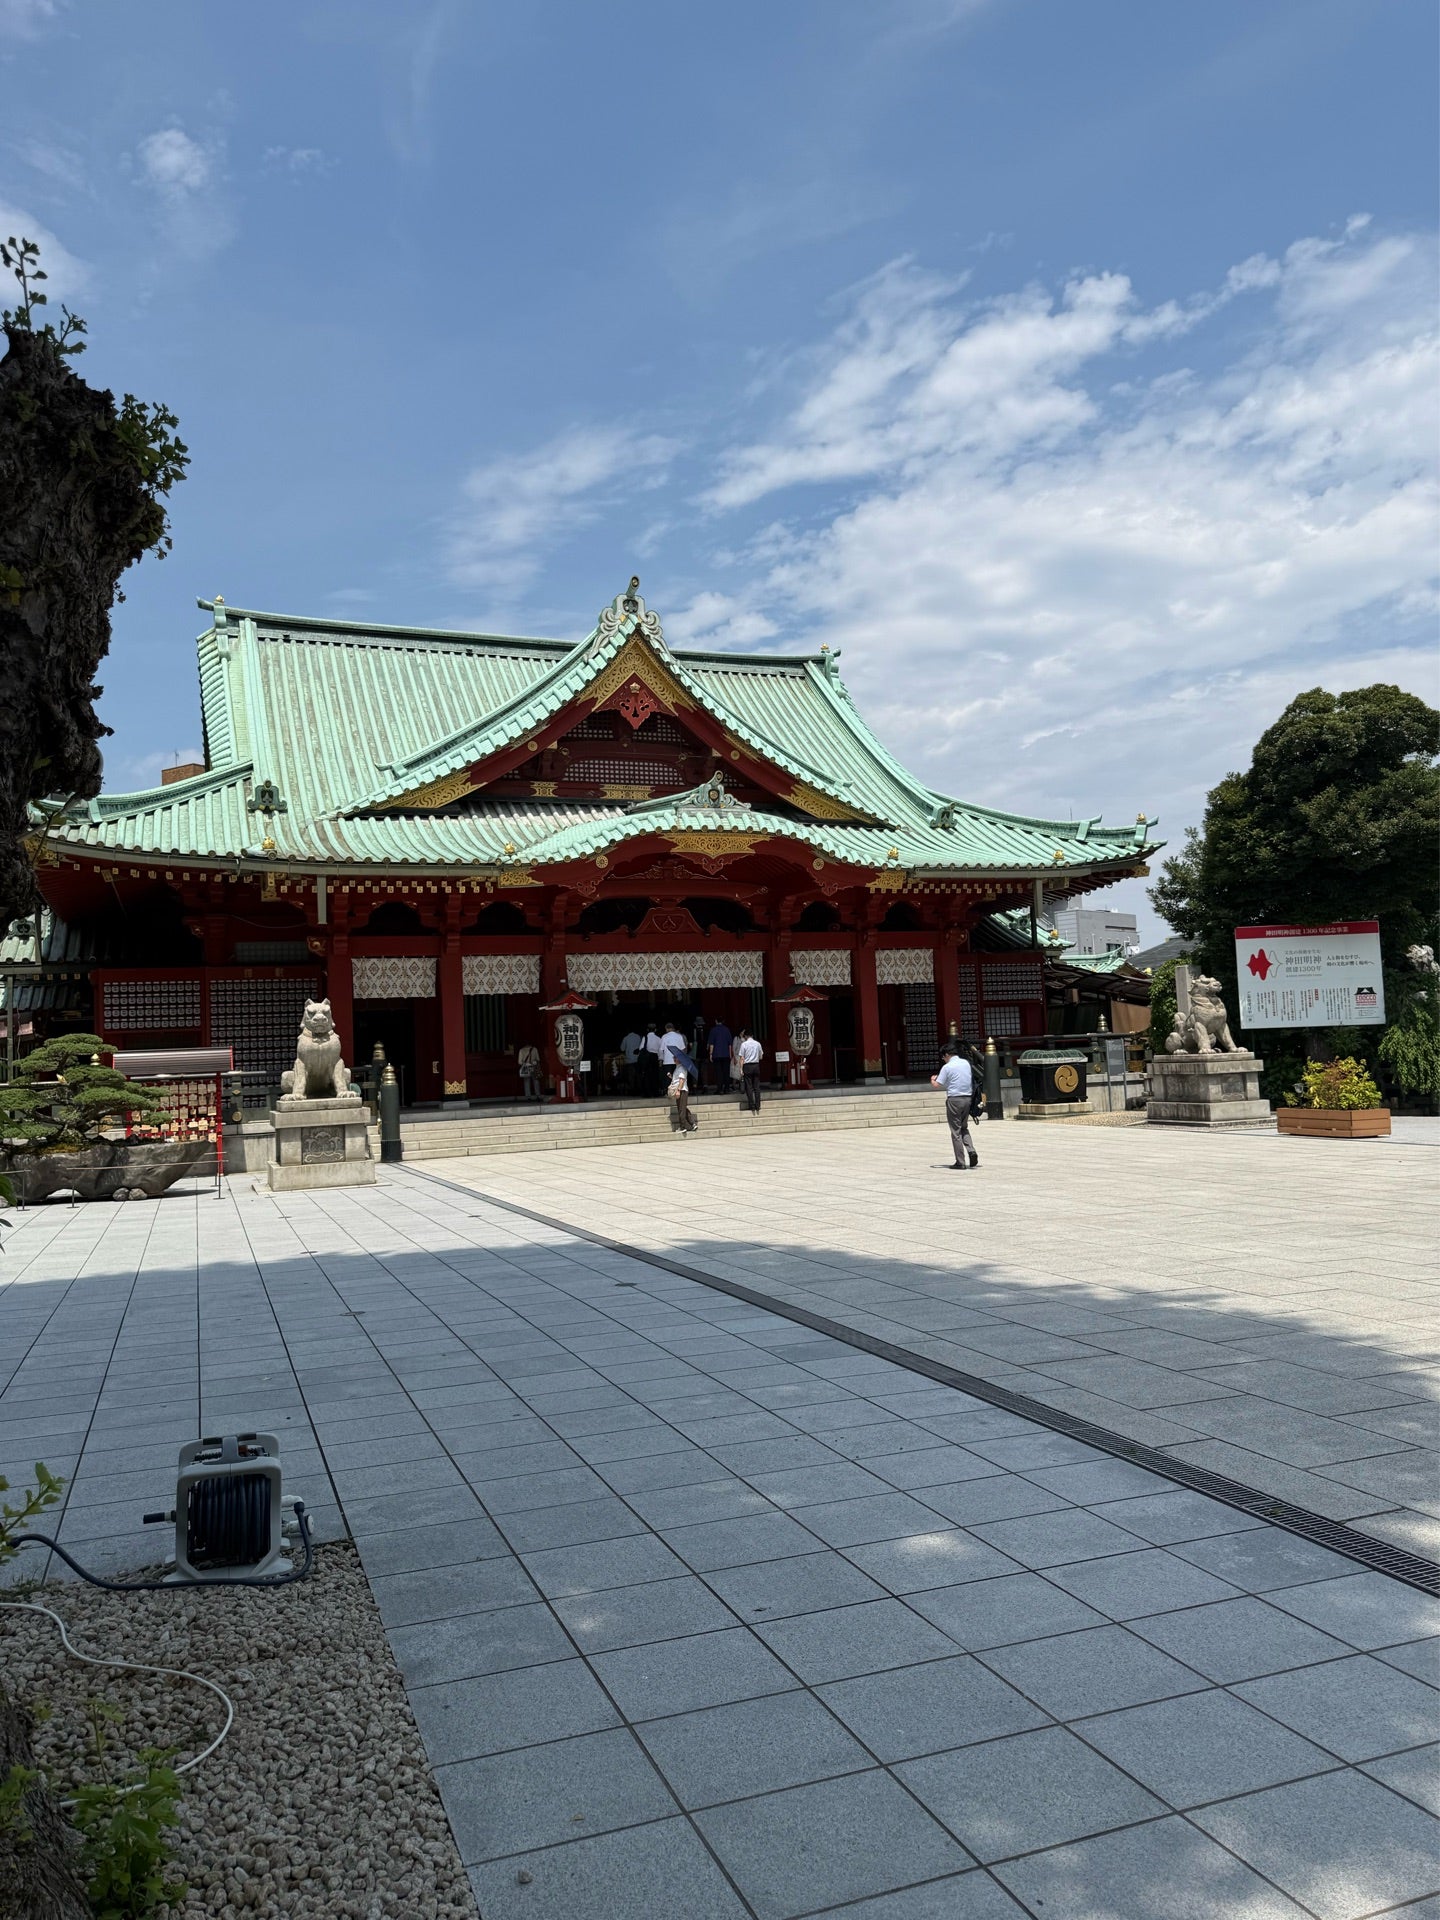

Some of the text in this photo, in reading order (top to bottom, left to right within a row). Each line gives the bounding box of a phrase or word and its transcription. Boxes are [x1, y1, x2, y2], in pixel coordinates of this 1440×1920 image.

[1285, 955, 1322, 965] 神田明神
[562, 1023, 580, 1058] 神田明神
[794, 1016, 810, 1049] 神田明神
